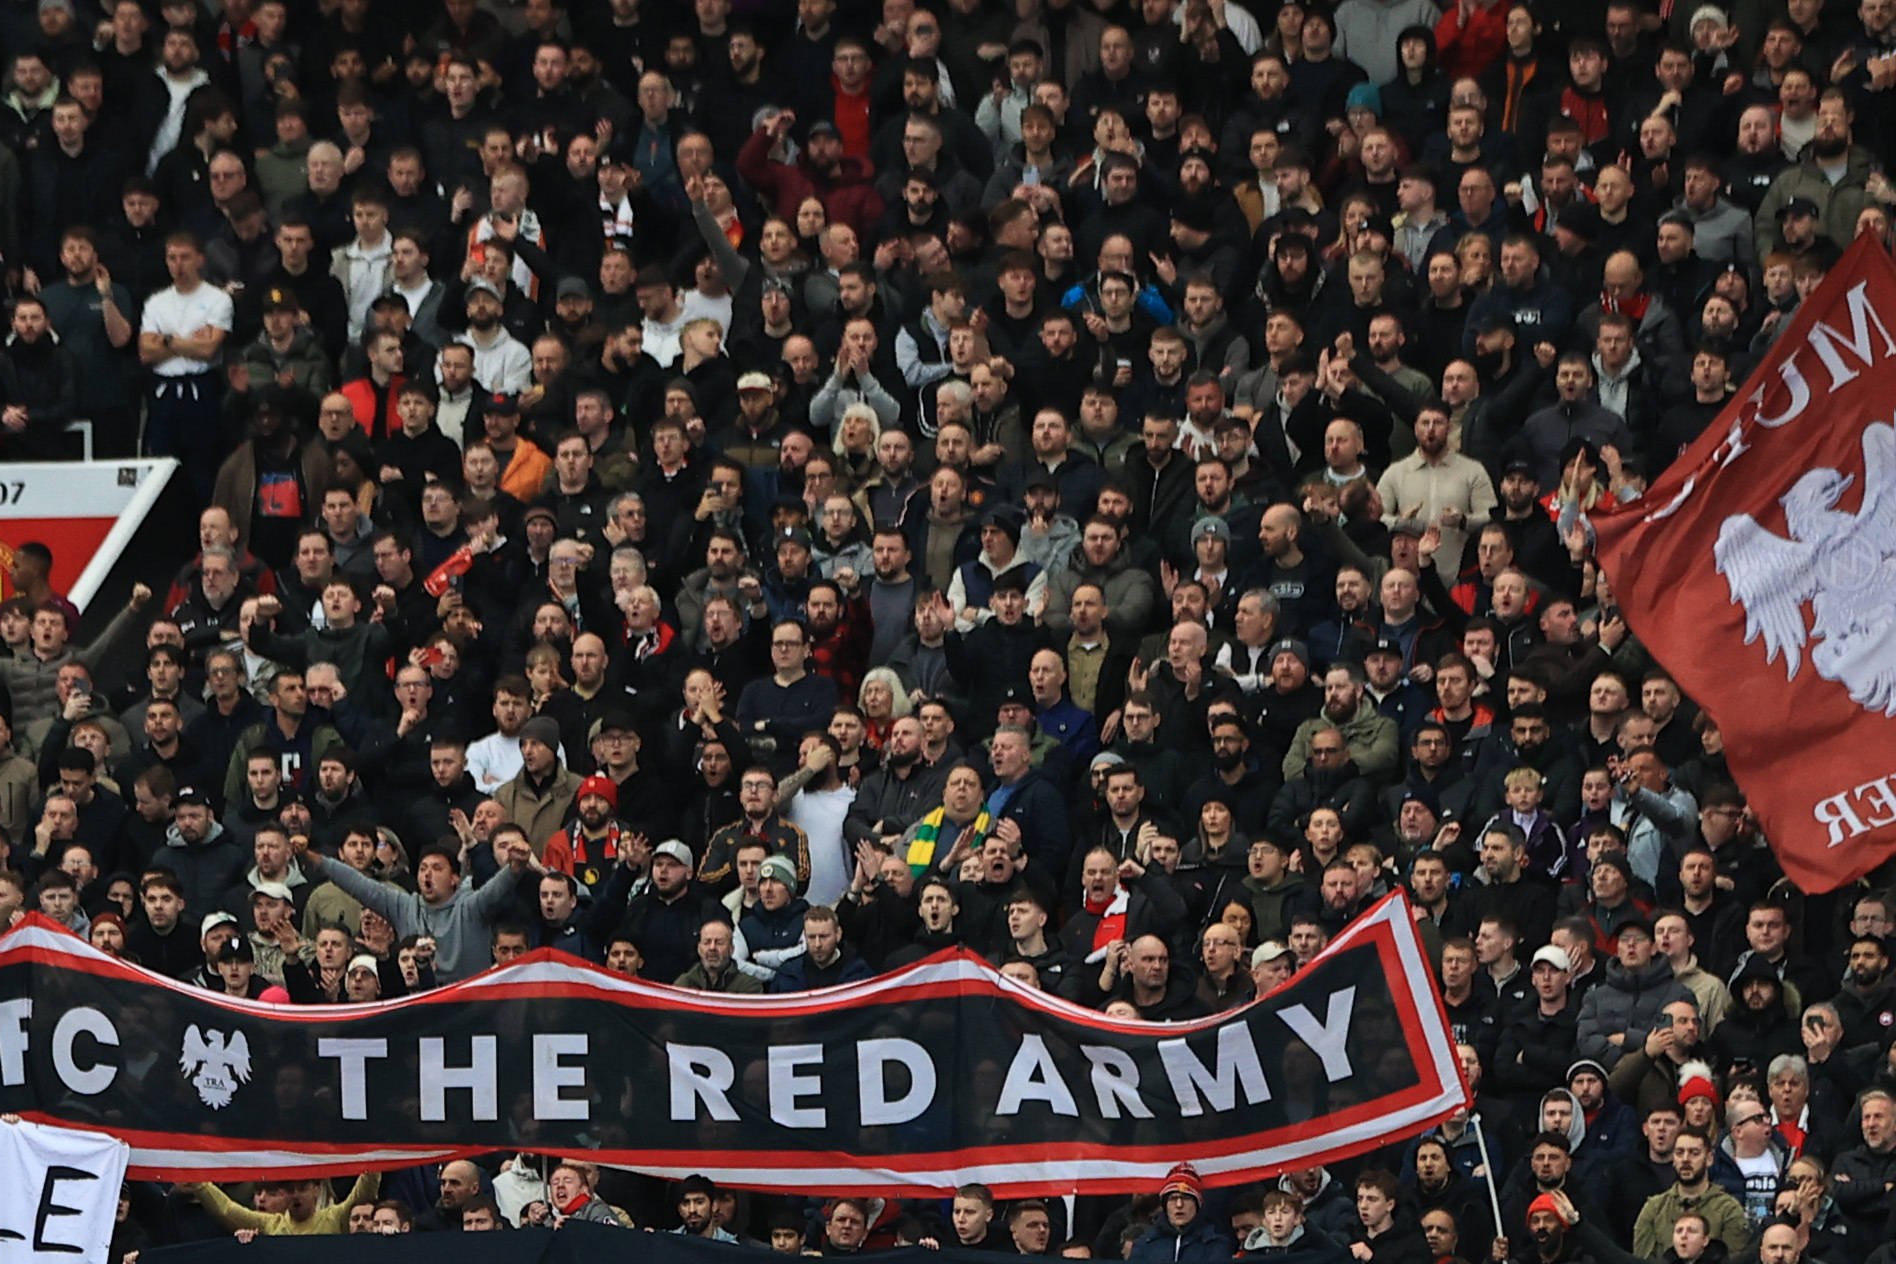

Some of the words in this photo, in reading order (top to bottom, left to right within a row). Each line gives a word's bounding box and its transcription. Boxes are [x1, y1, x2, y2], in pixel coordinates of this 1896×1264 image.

[317, 1033, 590, 1122] THE
[665, 1036, 938, 1130] RED
[995, 984, 1358, 1119] ARMY
